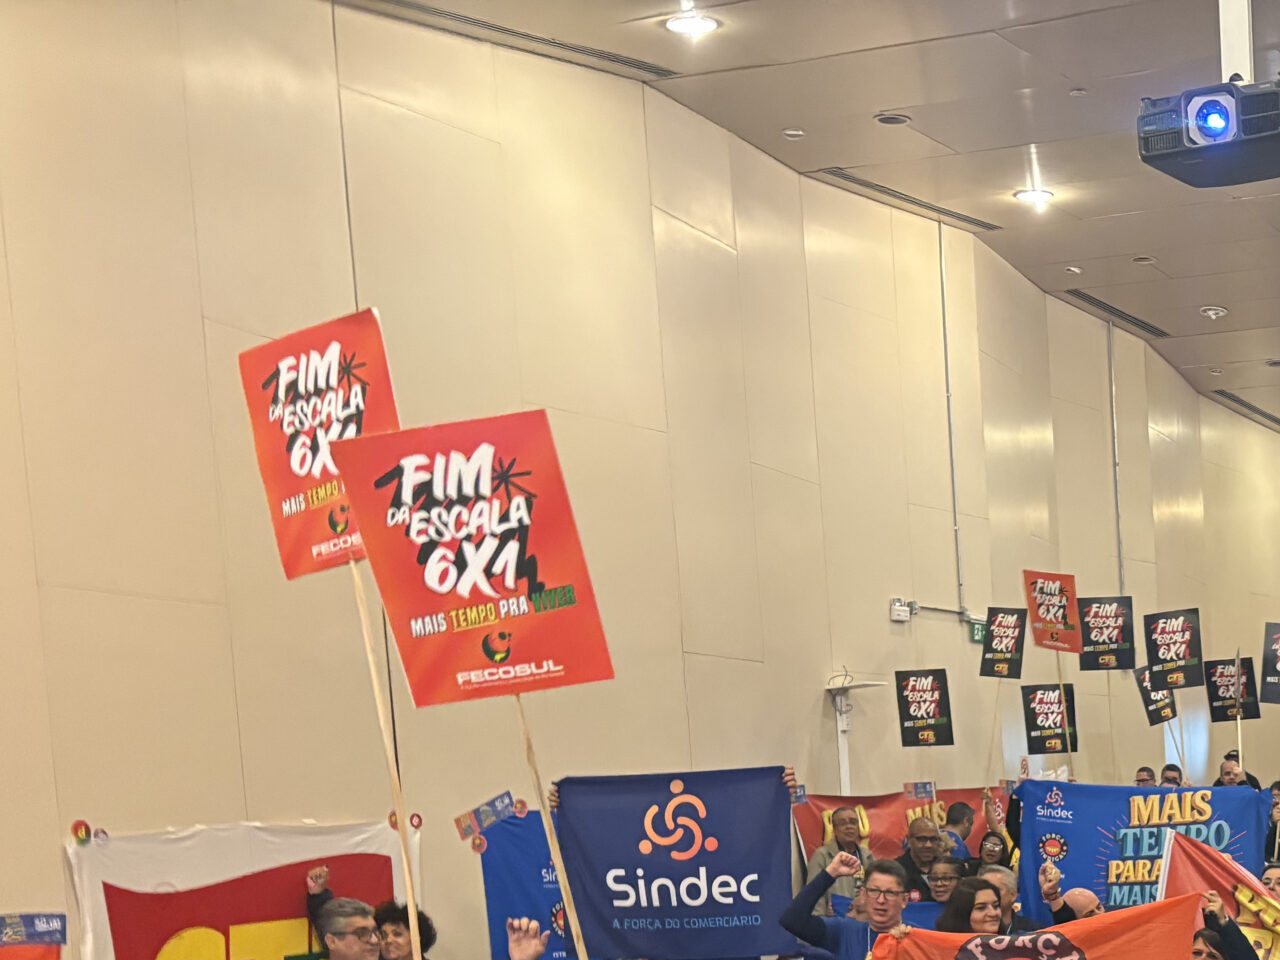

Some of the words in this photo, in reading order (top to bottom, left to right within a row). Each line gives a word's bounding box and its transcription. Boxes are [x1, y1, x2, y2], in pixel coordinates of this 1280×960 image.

[277, 341, 341, 402] FIM
[282, 384, 364, 433] ESCALA
[290, 424, 358, 478] 6X
[398, 442, 495, 505] FIM
[282, 493, 305, 518] MAIS
[307, 480, 340, 508] TEMPO
[386, 505, 410, 527] DA
[409, 496, 531, 544] ESCALA
[311, 531, 363, 559] FECOS
[423, 535, 519, 599] 6X1
[1035, 579, 1060, 594] FIM
[410, 612, 447, 638] MAIS
[449, 602, 498, 631] TEMPO
[499, 593, 529, 618] PRA
[531, 585, 576, 613] VIVER
[1038, 604, 1065, 623] 6X1
[1090, 603, 1118, 618] FIM
[994, 613, 1018, 627] FIM
[1157, 616, 1184, 633] FIM
[1090, 627, 1119, 643] 6X1
[992, 637, 1015, 652] 6X1
[1158, 643, 1186, 660] 6X1
[456, 659, 564, 686] FECOSUL
[908, 676, 933, 690] FIM
[1036, 690, 1060, 703] FIM
[909, 701, 935, 718] 6X1
[1037, 712, 1062, 728] 6X1
[1037, 805, 1073, 819] Sindec
[1129, 790, 1212, 827] MAIS
[606, 866, 760, 907] Sindec
[612, 918, 621, 929] A
[625, 918, 662, 930] FORÇA
[665, 918, 681, 929] DO
